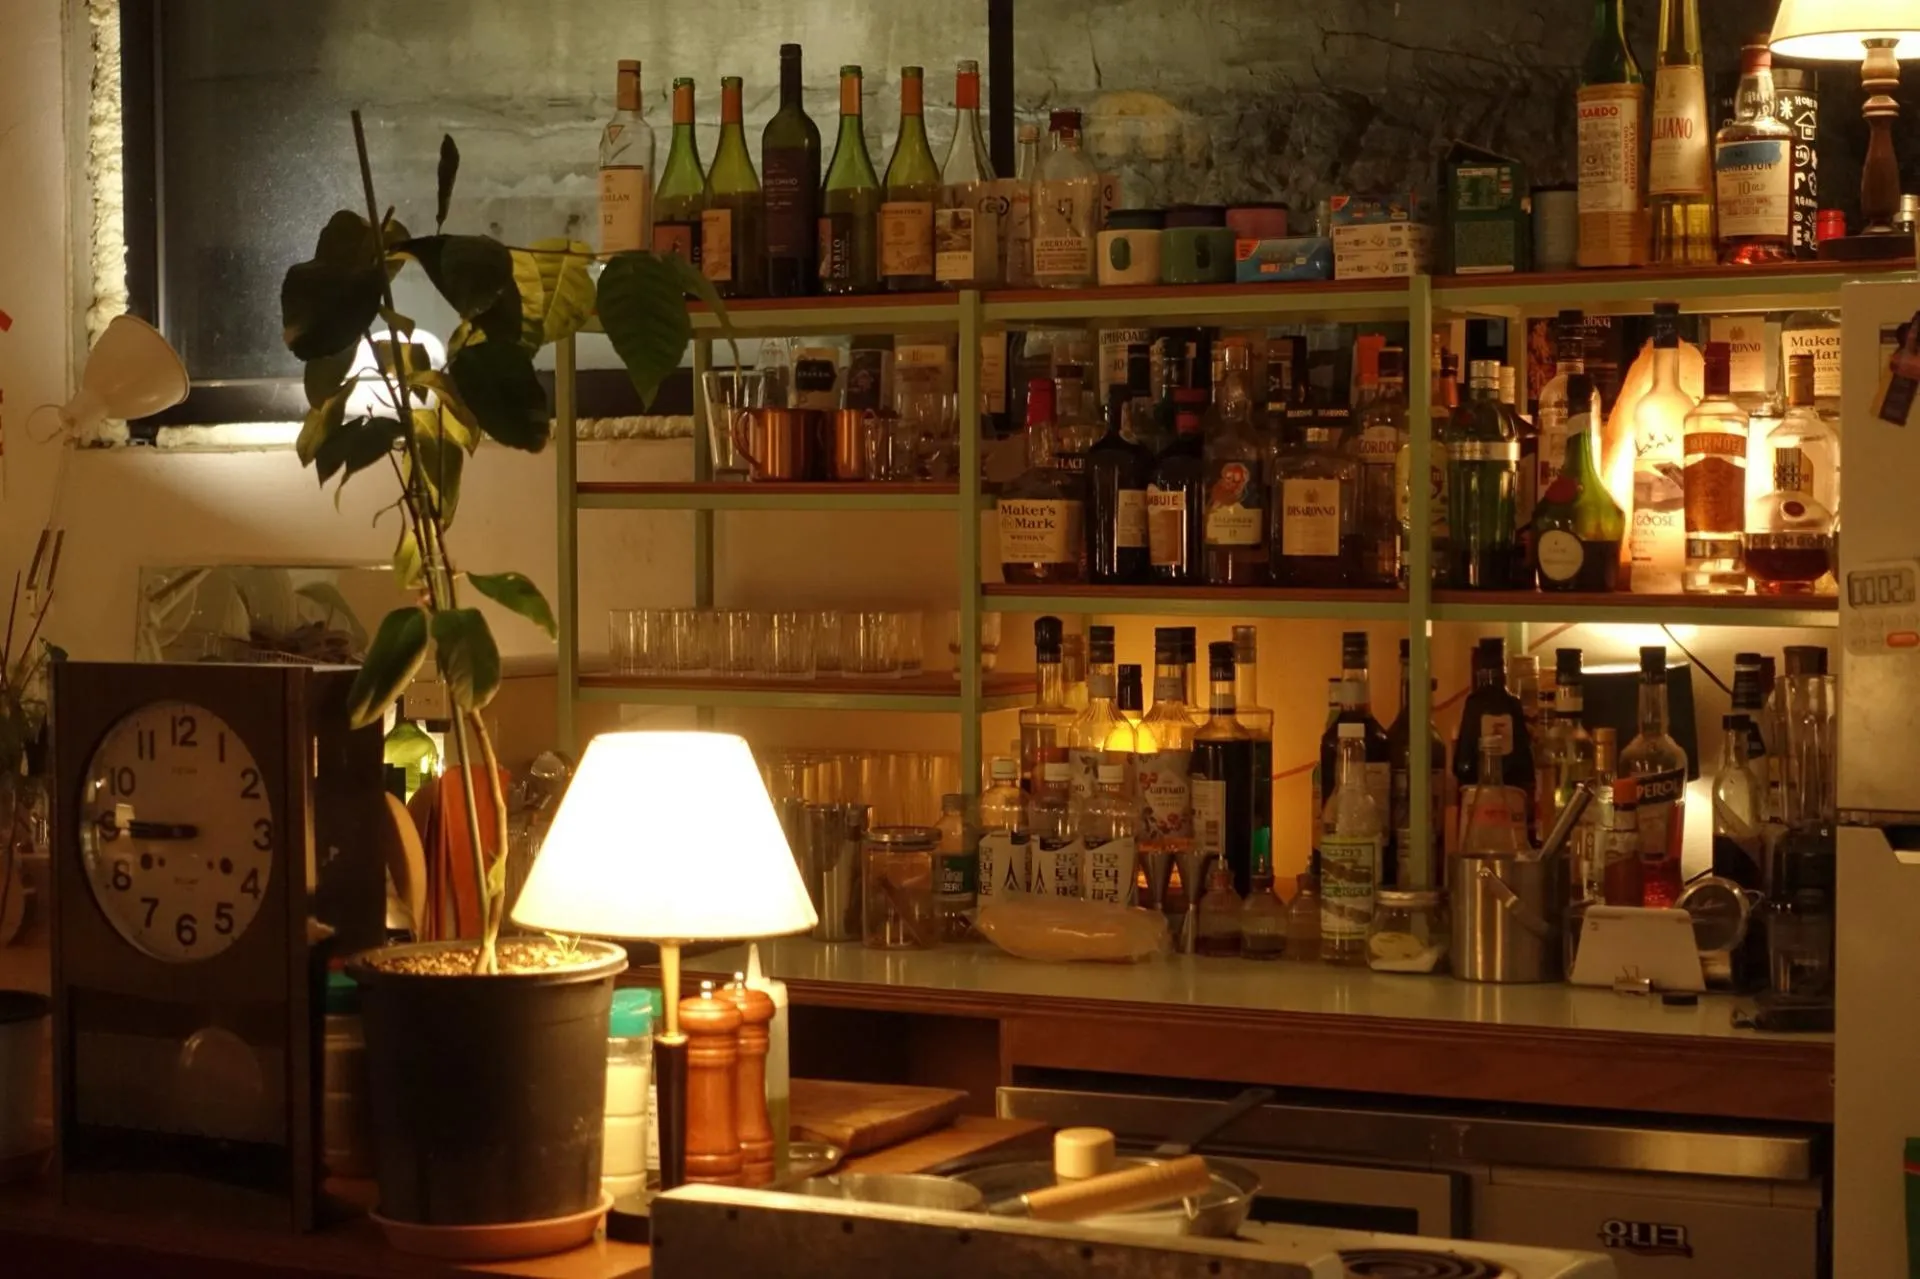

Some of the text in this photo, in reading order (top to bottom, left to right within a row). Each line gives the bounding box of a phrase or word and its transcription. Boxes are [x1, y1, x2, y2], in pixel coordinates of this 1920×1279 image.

[1001, 504, 1056, 517] Maker's
[1014, 517, 1055, 530] Mark
[138, 730, 155, 760] 11
[171, 716, 198, 747] 12
[218, 732, 226, 763] 1
[109, 766, 137, 797] 10
[240, 768, 261, 799] 2
[100, 810, 121, 842] 9
[253, 818, 272, 850] 3
[112, 860, 132, 891] 8
[240, 868, 261, 899] 4
[140, 898, 159, 928] 7
[214, 902, 234, 934] 5
[175, 913, 197, 946] 6
